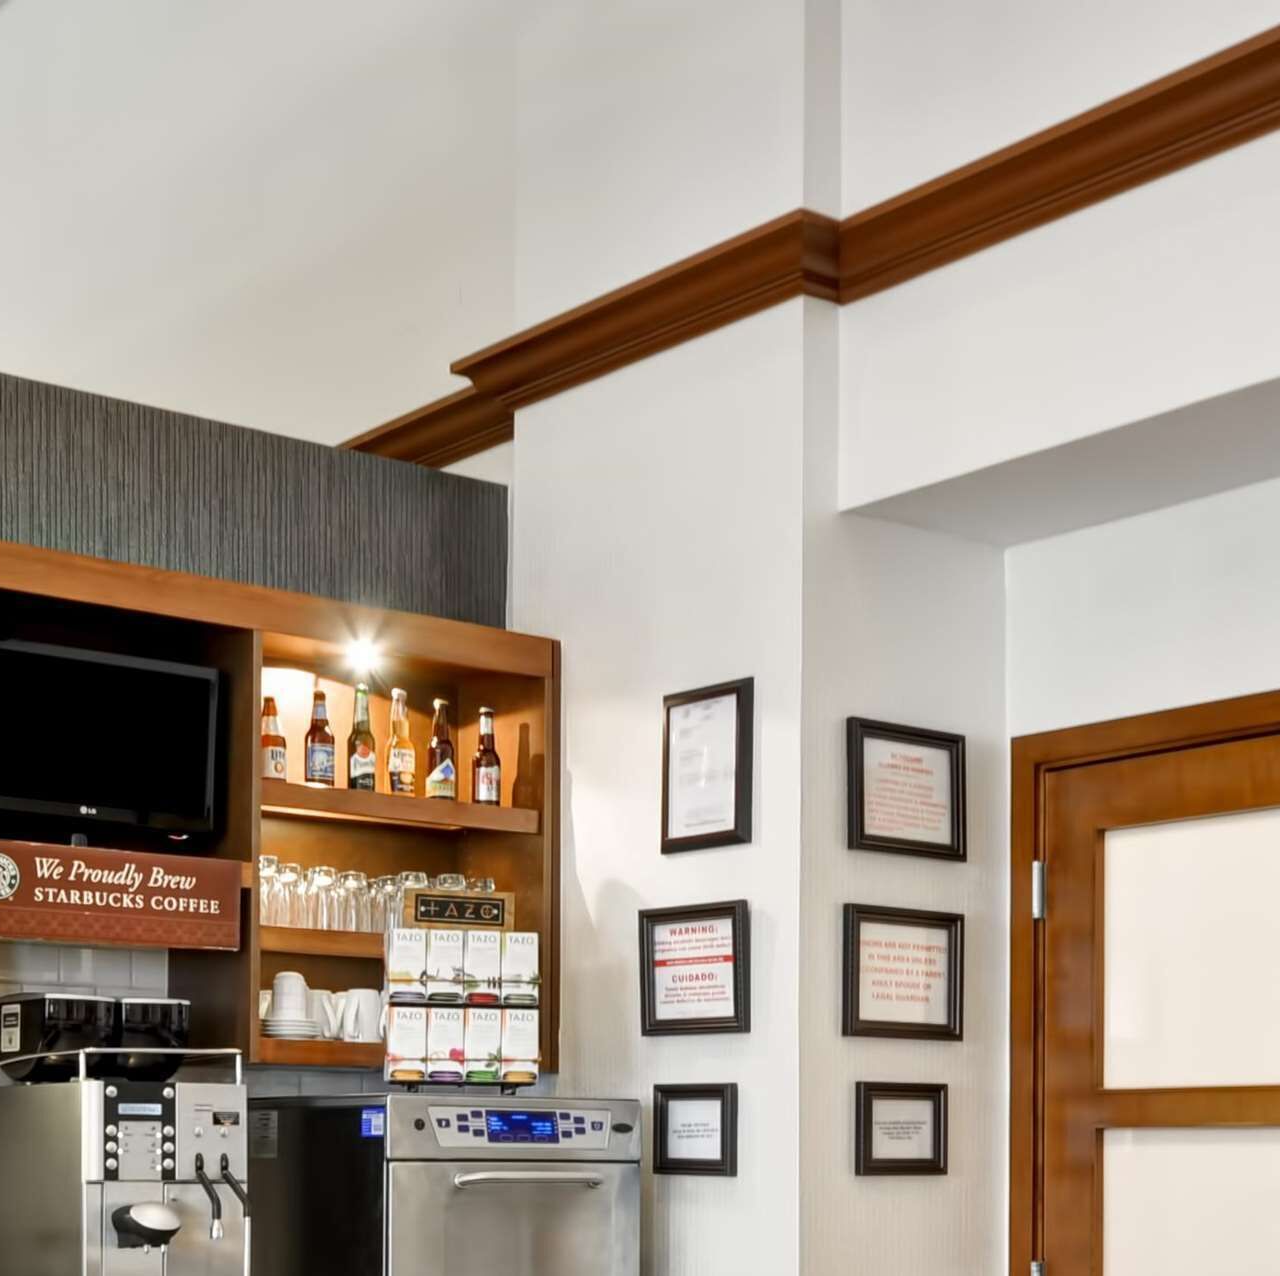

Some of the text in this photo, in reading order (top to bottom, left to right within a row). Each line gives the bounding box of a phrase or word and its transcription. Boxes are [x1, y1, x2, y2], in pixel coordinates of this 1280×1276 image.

[34, 856, 197, 892] We Proudly Brew
[33, 886, 221, 914] STARBUCKS COFFEE
